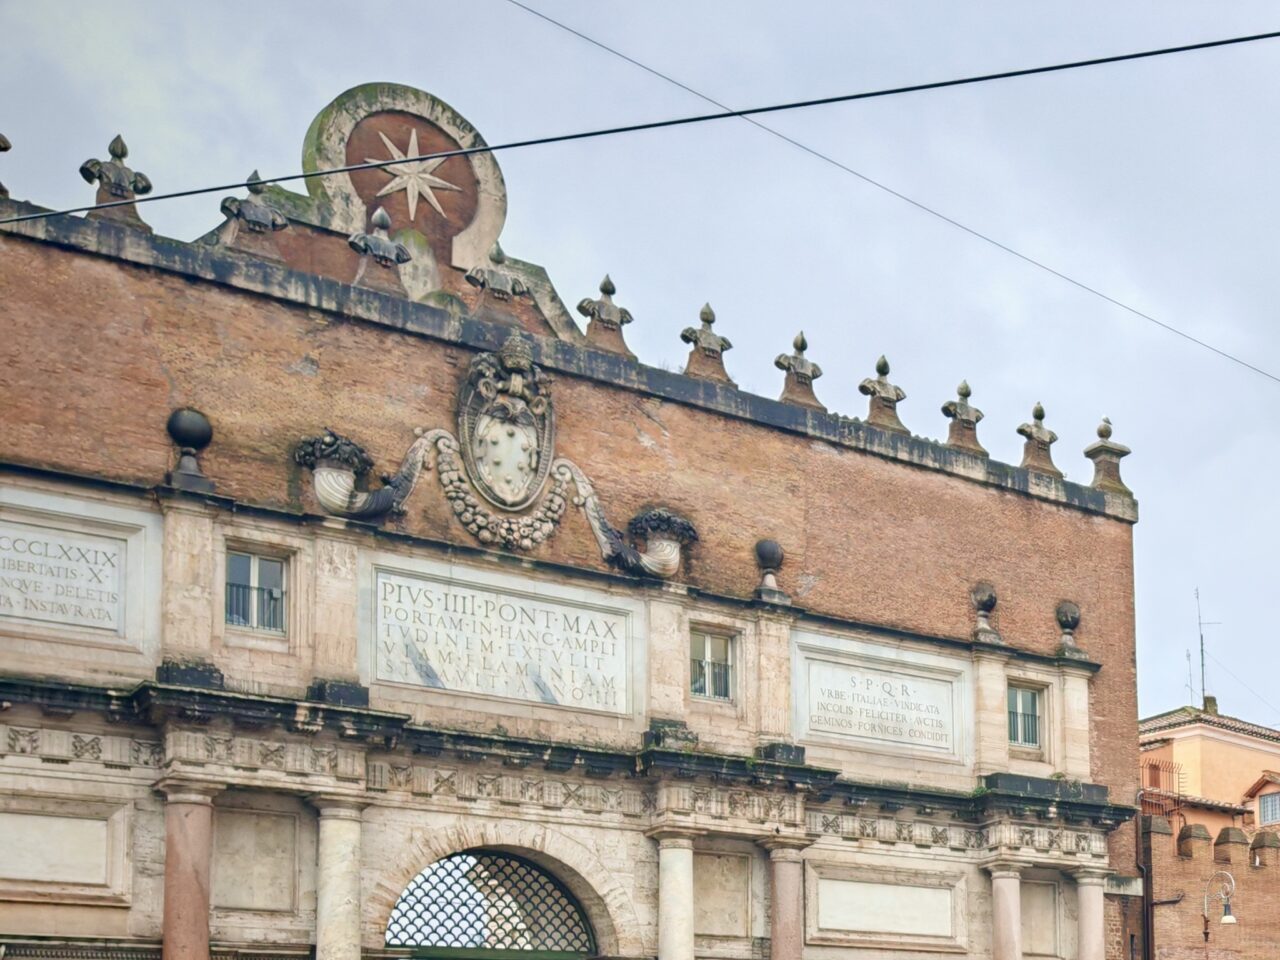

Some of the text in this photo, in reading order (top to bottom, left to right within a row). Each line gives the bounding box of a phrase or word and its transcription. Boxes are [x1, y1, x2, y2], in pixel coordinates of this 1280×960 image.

[55, 583, 119, 604] DELETIS
[382, 582, 434, 608] PIVS
[484, 599, 556, 629] PONT
[562, 613, 617, 640] MAX
[383, 605, 463, 632] PORTAM
[500, 624, 554, 646] HANC
[562, 636, 617, 656] AMPLI
